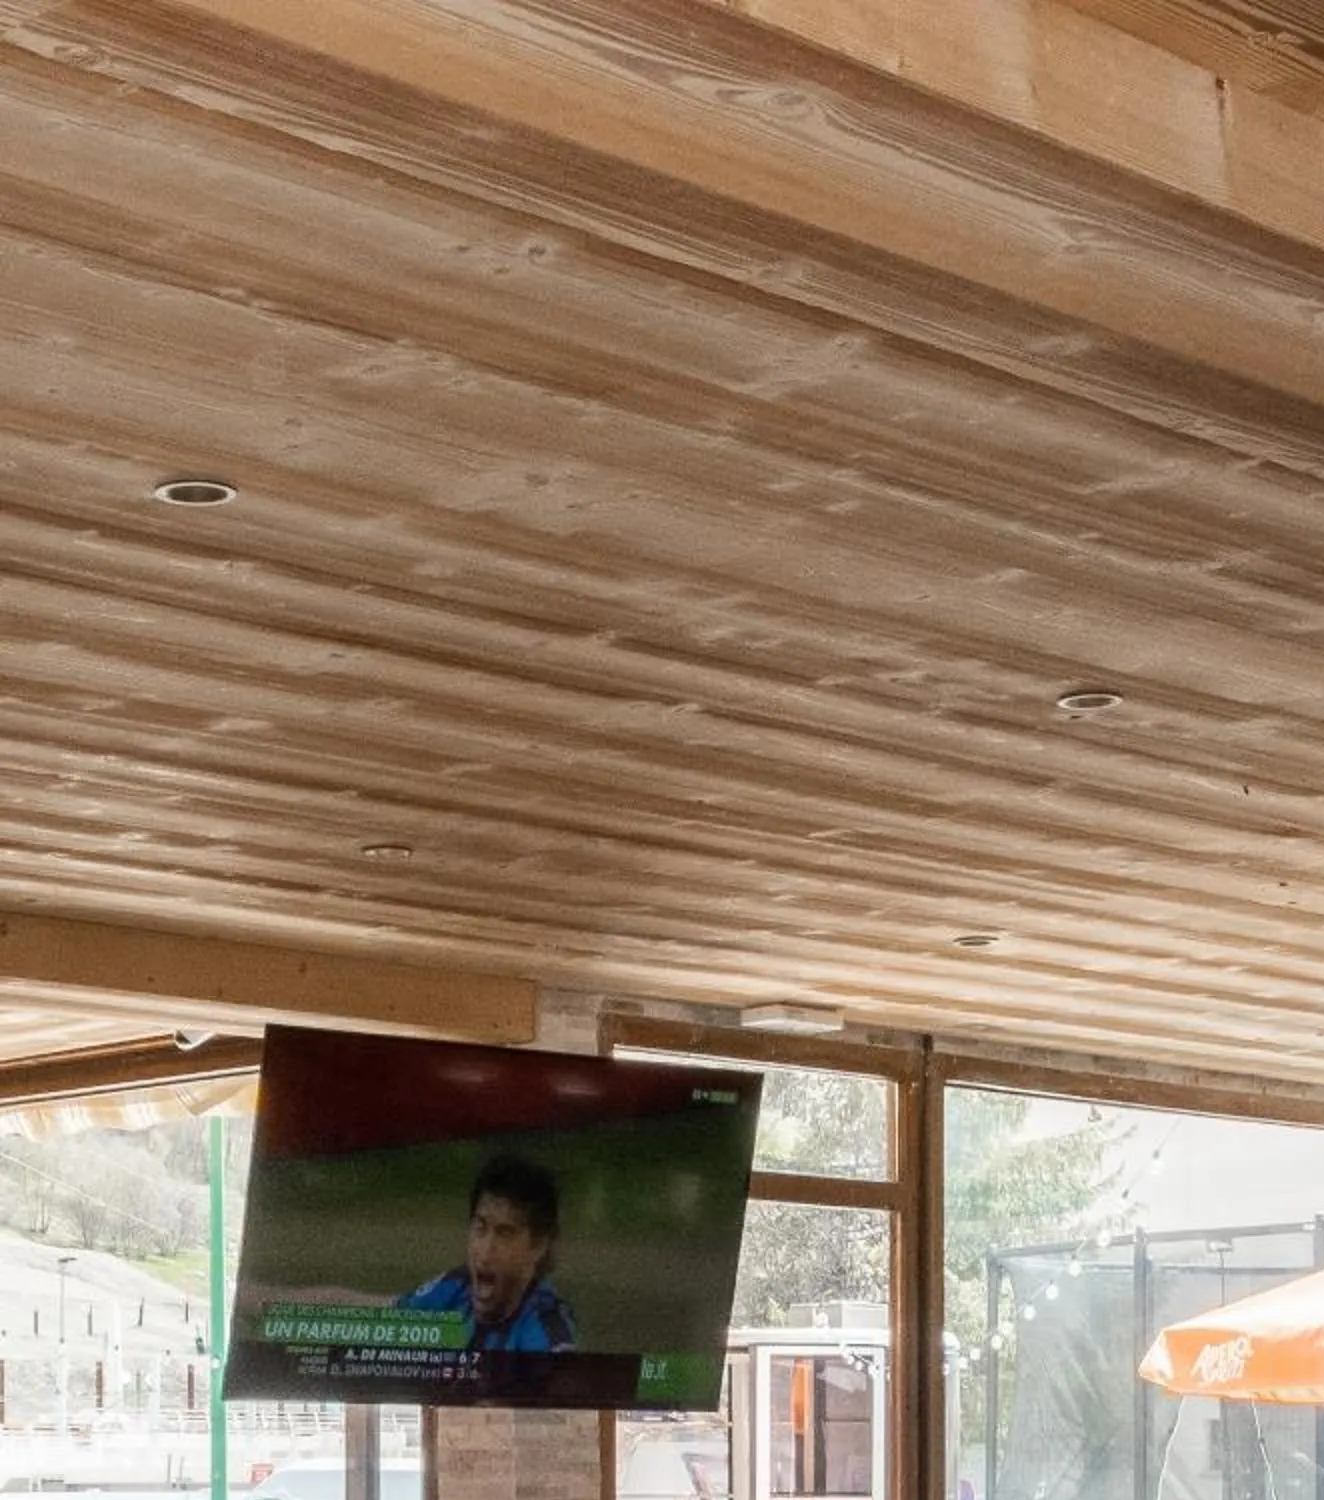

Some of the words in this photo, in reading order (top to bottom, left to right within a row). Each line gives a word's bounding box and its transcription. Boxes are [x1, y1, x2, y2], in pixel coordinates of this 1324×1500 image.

[264, 1320, 295, 1338] UN
[296, 1321, 370, 1342] PARFUM
[371, 1324, 397, 1343] DE
[400, 1325, 442, 1345] 2010
